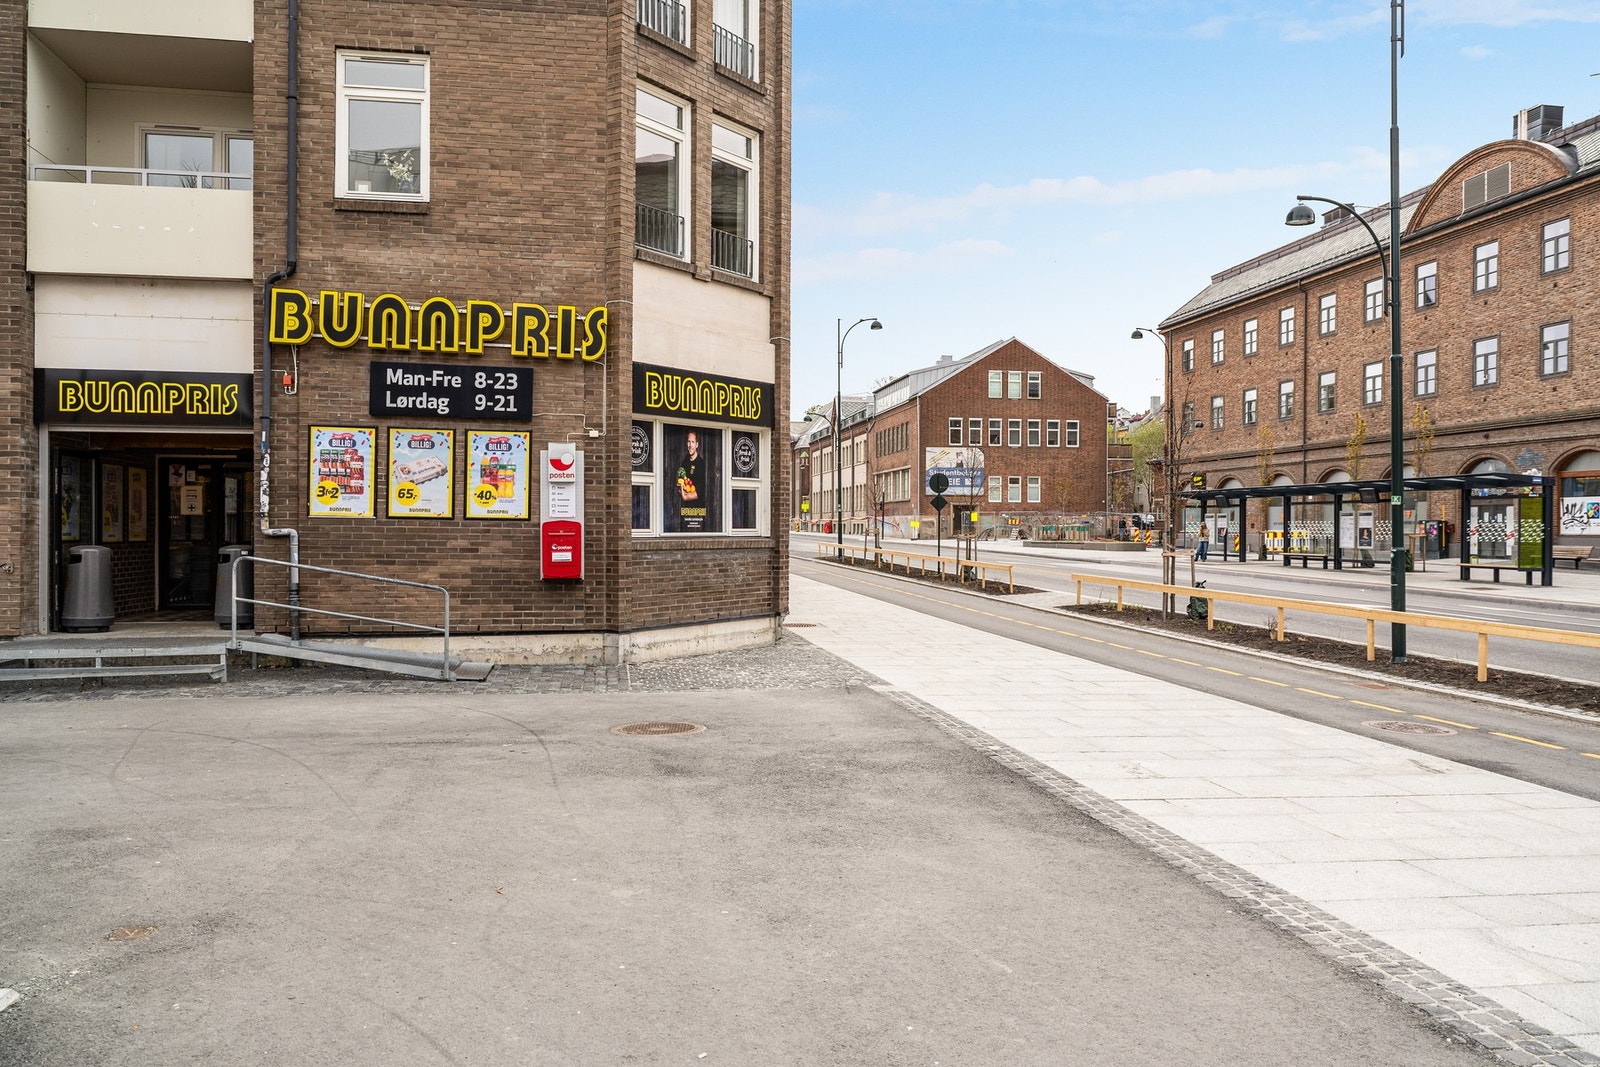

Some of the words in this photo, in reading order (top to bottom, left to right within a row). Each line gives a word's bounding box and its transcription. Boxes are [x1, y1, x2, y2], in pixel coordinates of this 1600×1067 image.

[269, 288, 608, 362] BUNNPRIS
[386, 368, 462, 388] Man-Fre
[474, 372, 518, 390] 8-23
[59, 380, 239, 415] BUNNPRIS
[385, 391, 450, 413] Lørdag
[474, 394, 518, 412] 9-21
[646, 371, 761, 420] BUNNPRIS
[488, 441, 509, 451] BILLIG!
[549, 472, 575, 480] posten
